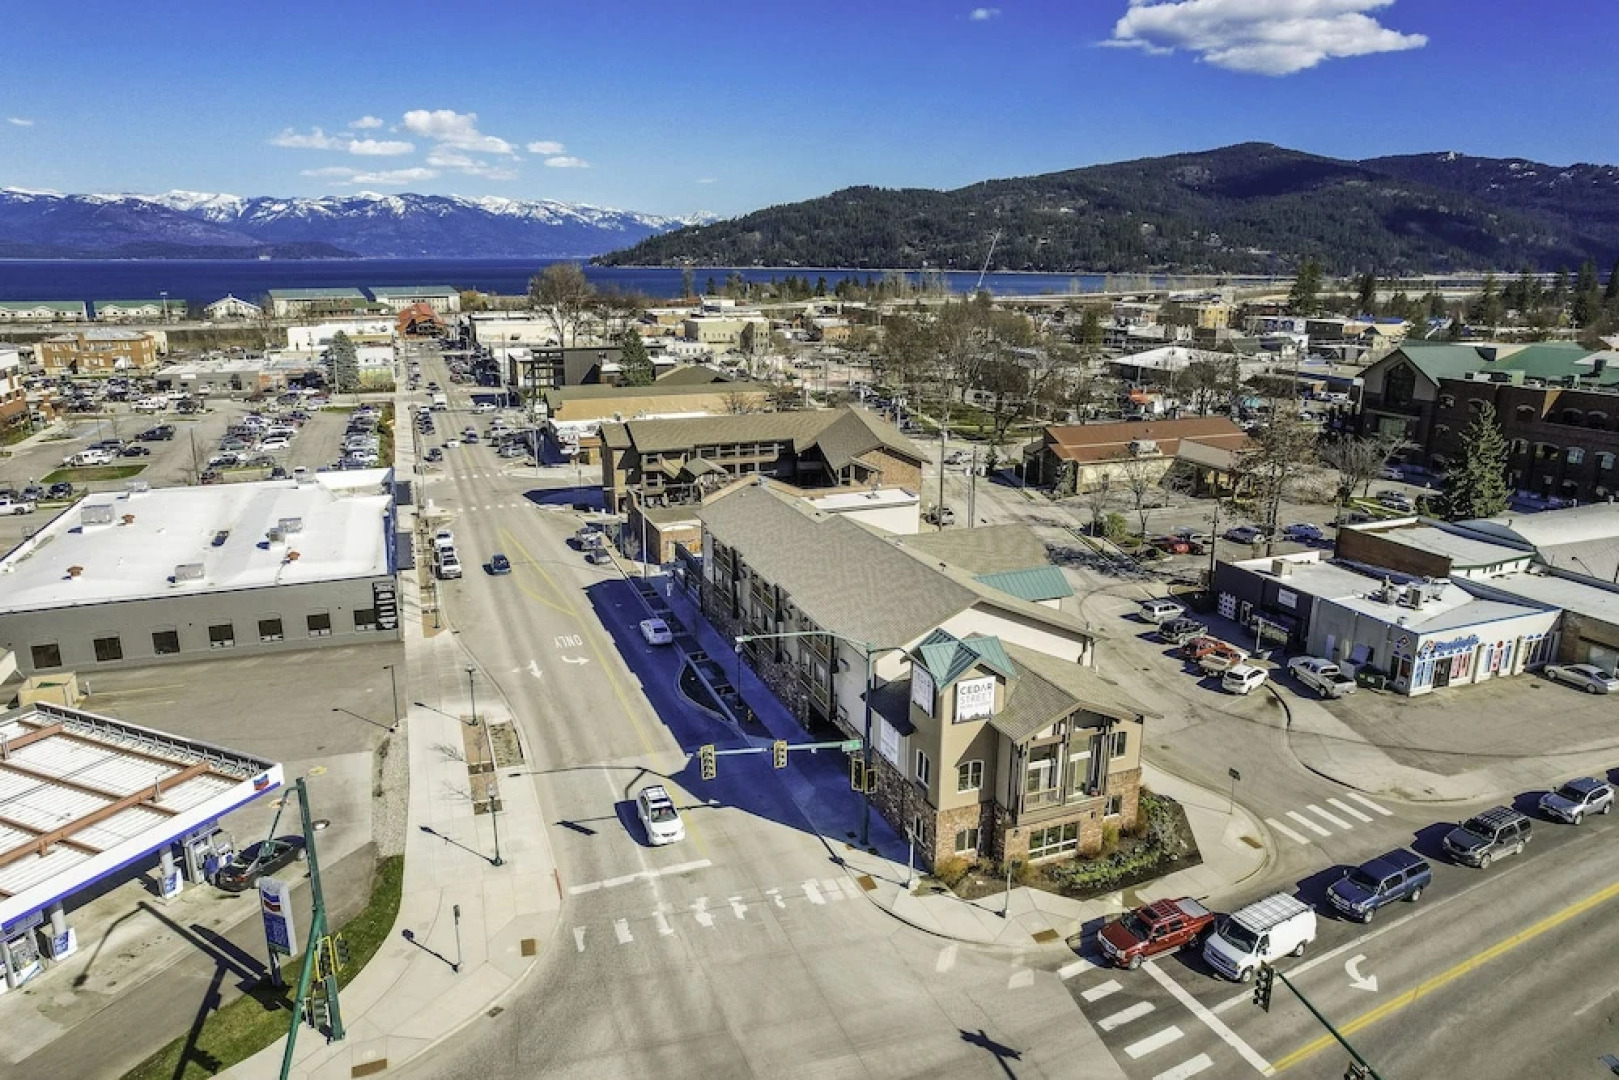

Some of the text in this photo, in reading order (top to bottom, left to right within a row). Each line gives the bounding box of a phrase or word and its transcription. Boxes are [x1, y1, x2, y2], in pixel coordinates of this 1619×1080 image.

[554, 635, 583, 648] ONLY
[960, 682, 993, 695] CEDAR
[960, 691, 992, 705] STREET
